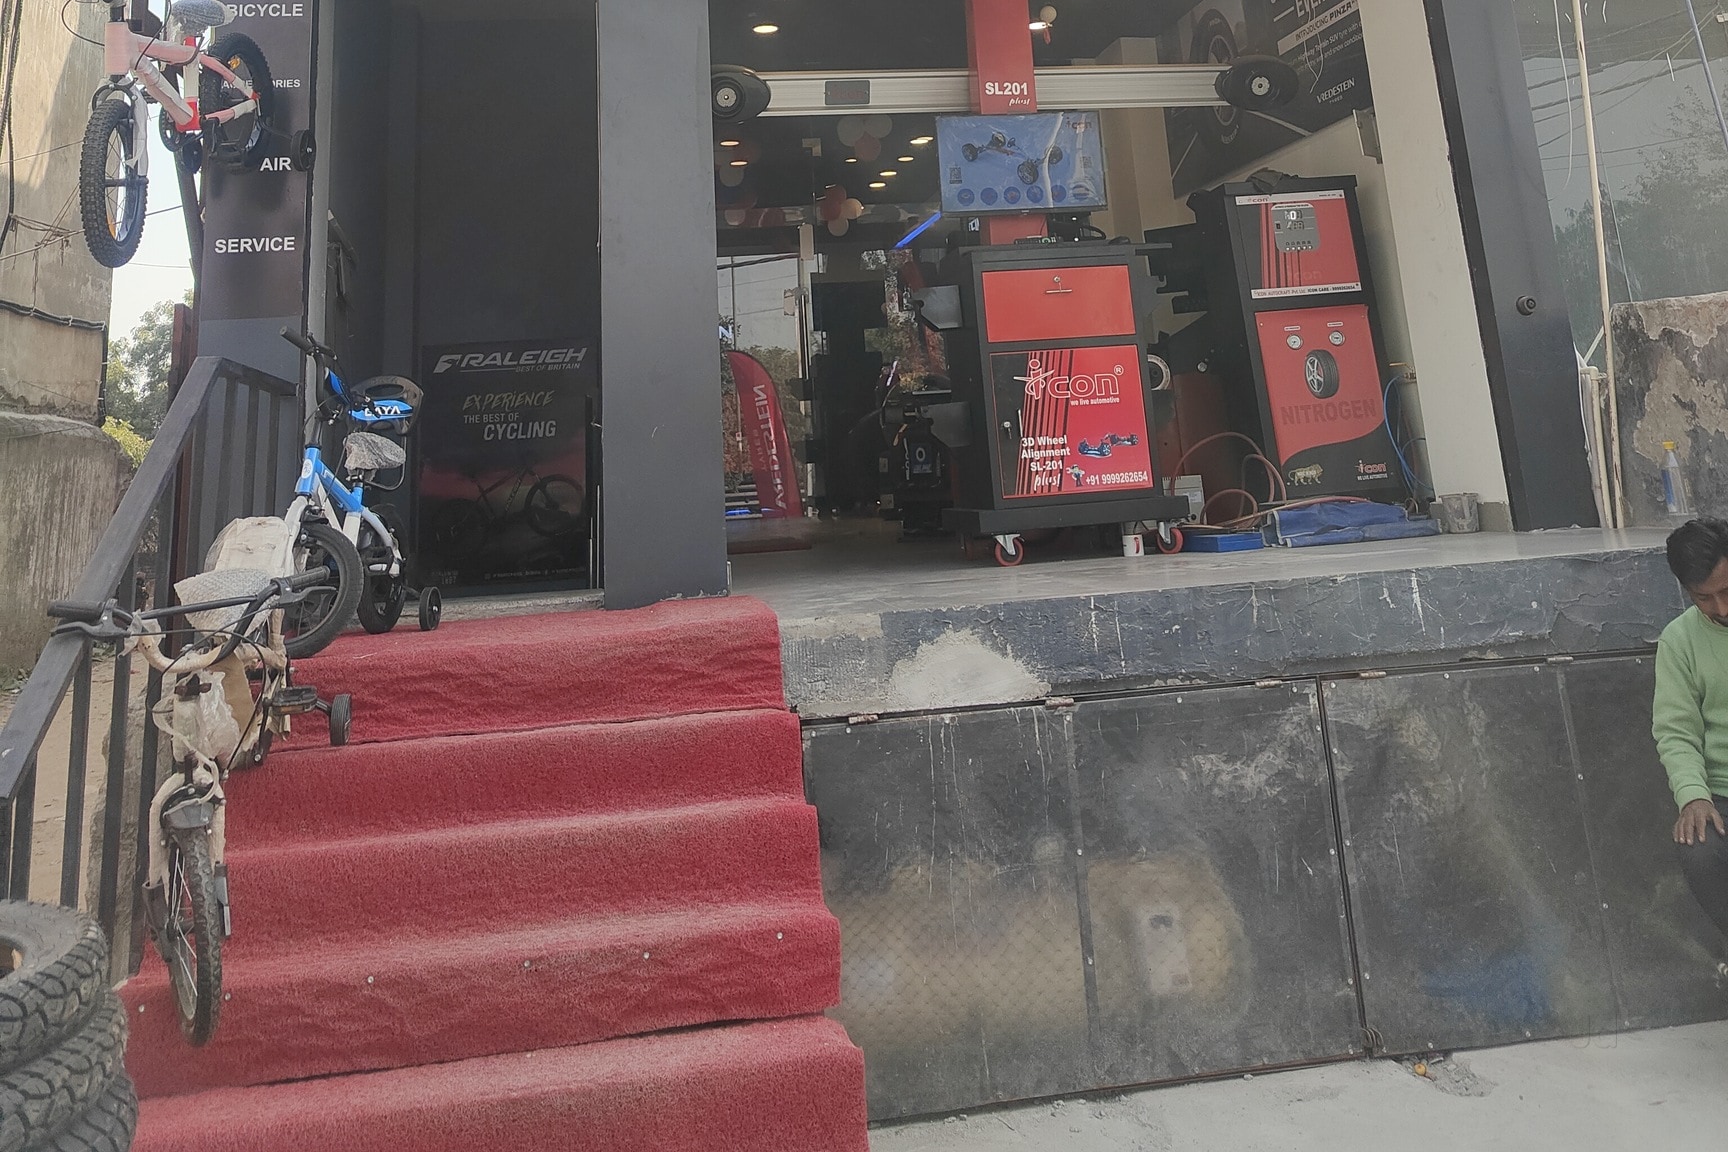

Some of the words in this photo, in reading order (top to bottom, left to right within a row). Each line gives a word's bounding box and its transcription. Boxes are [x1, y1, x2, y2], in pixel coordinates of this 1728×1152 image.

[227, 2, 304, 18] BICYCLE
[985, 81, 1028, 96] SL201
[1316, 77, 1355, 104] VREDESTEIN
[260, 157, 292, 172] AIR
[214, 236, 296, 254] SERVICE
[460, 347, 588, 368] RALEIGH
[463, 414, 480, 424] THE
[483, 413, 506, 423] BEST
[508, 412, 519, 422] OF
[1280, 398, 1376, 426] NITROGEN
[483, 419, 557, 441] CYCLING
[1021, 436, 1035, 447] 3D
[1037, 434, 1068, 446] Wheel
[1021, 446, 1071, 460] Alignment
[1030, 460, 1063, 472] SL-201
[1085, 474, 1099, 486] +91
[1100, 471, 1148, 486] 9999262654
